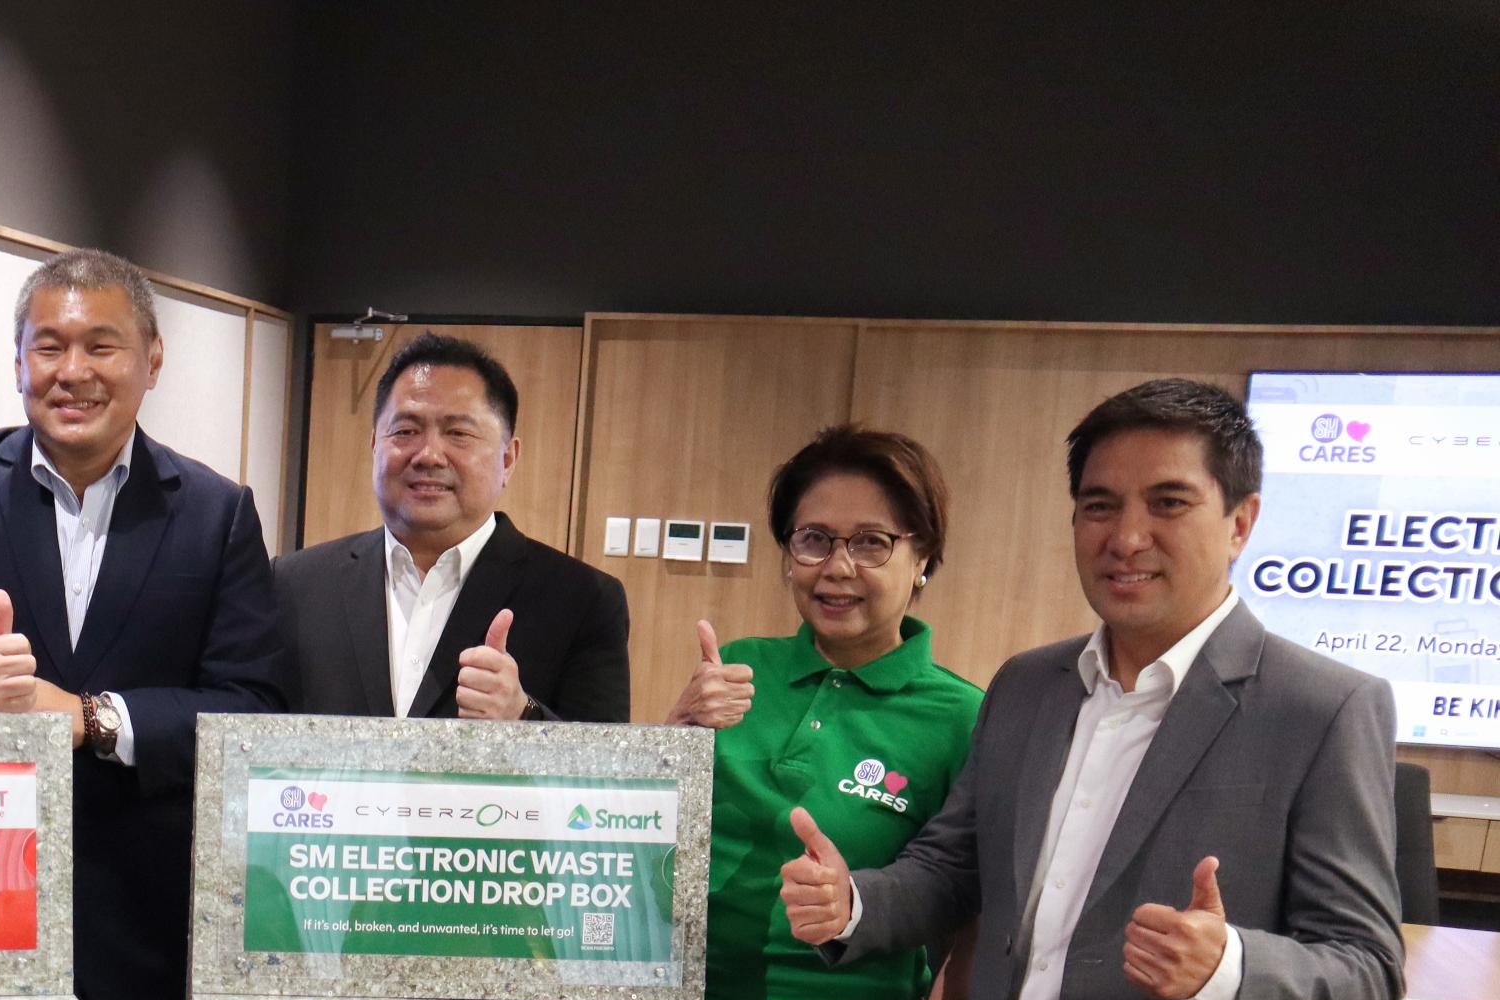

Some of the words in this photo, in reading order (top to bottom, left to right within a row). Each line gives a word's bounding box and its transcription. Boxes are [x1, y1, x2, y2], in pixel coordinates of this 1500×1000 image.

[1408, 435, 1500, 447] CYBE
[1298, 445, 1376, 463] CARES
[1346, 513, 1500, 550] ELECT
[1314, 631, 1367, 653] April
[1376, 634, 1407, 654] 22,
[1433, 696, 1461, 717] BE
[838, 779, 909, 813] CARES
[272, 812, 334, 829] CARES
[355, 803, 540, 827] CYBERZONE
[595, 809, 662, 830] Smart
[289, 844, 336, 869] SM
[342, 845, 526, 874] ELECTRONIC
[530, 850, 634, 877] WASTE
[289, 876, 476, 904] COLLECTION
[481, 880, 566, 907] DROP
[570, 883, 632, 908] BOX
[304, 919, 312, 931] If
[332, 920, 352, 932] old,
[355, 920, 396, 934] broken,
[398, 922, 419, 933] and
[422, 923, 480, 936] unwanted,
[500, 924, 525, 936] time
[527, 926, 538, 936] to
[541, 926, 554, 936] let
[557, 926, 574, 939] go!
